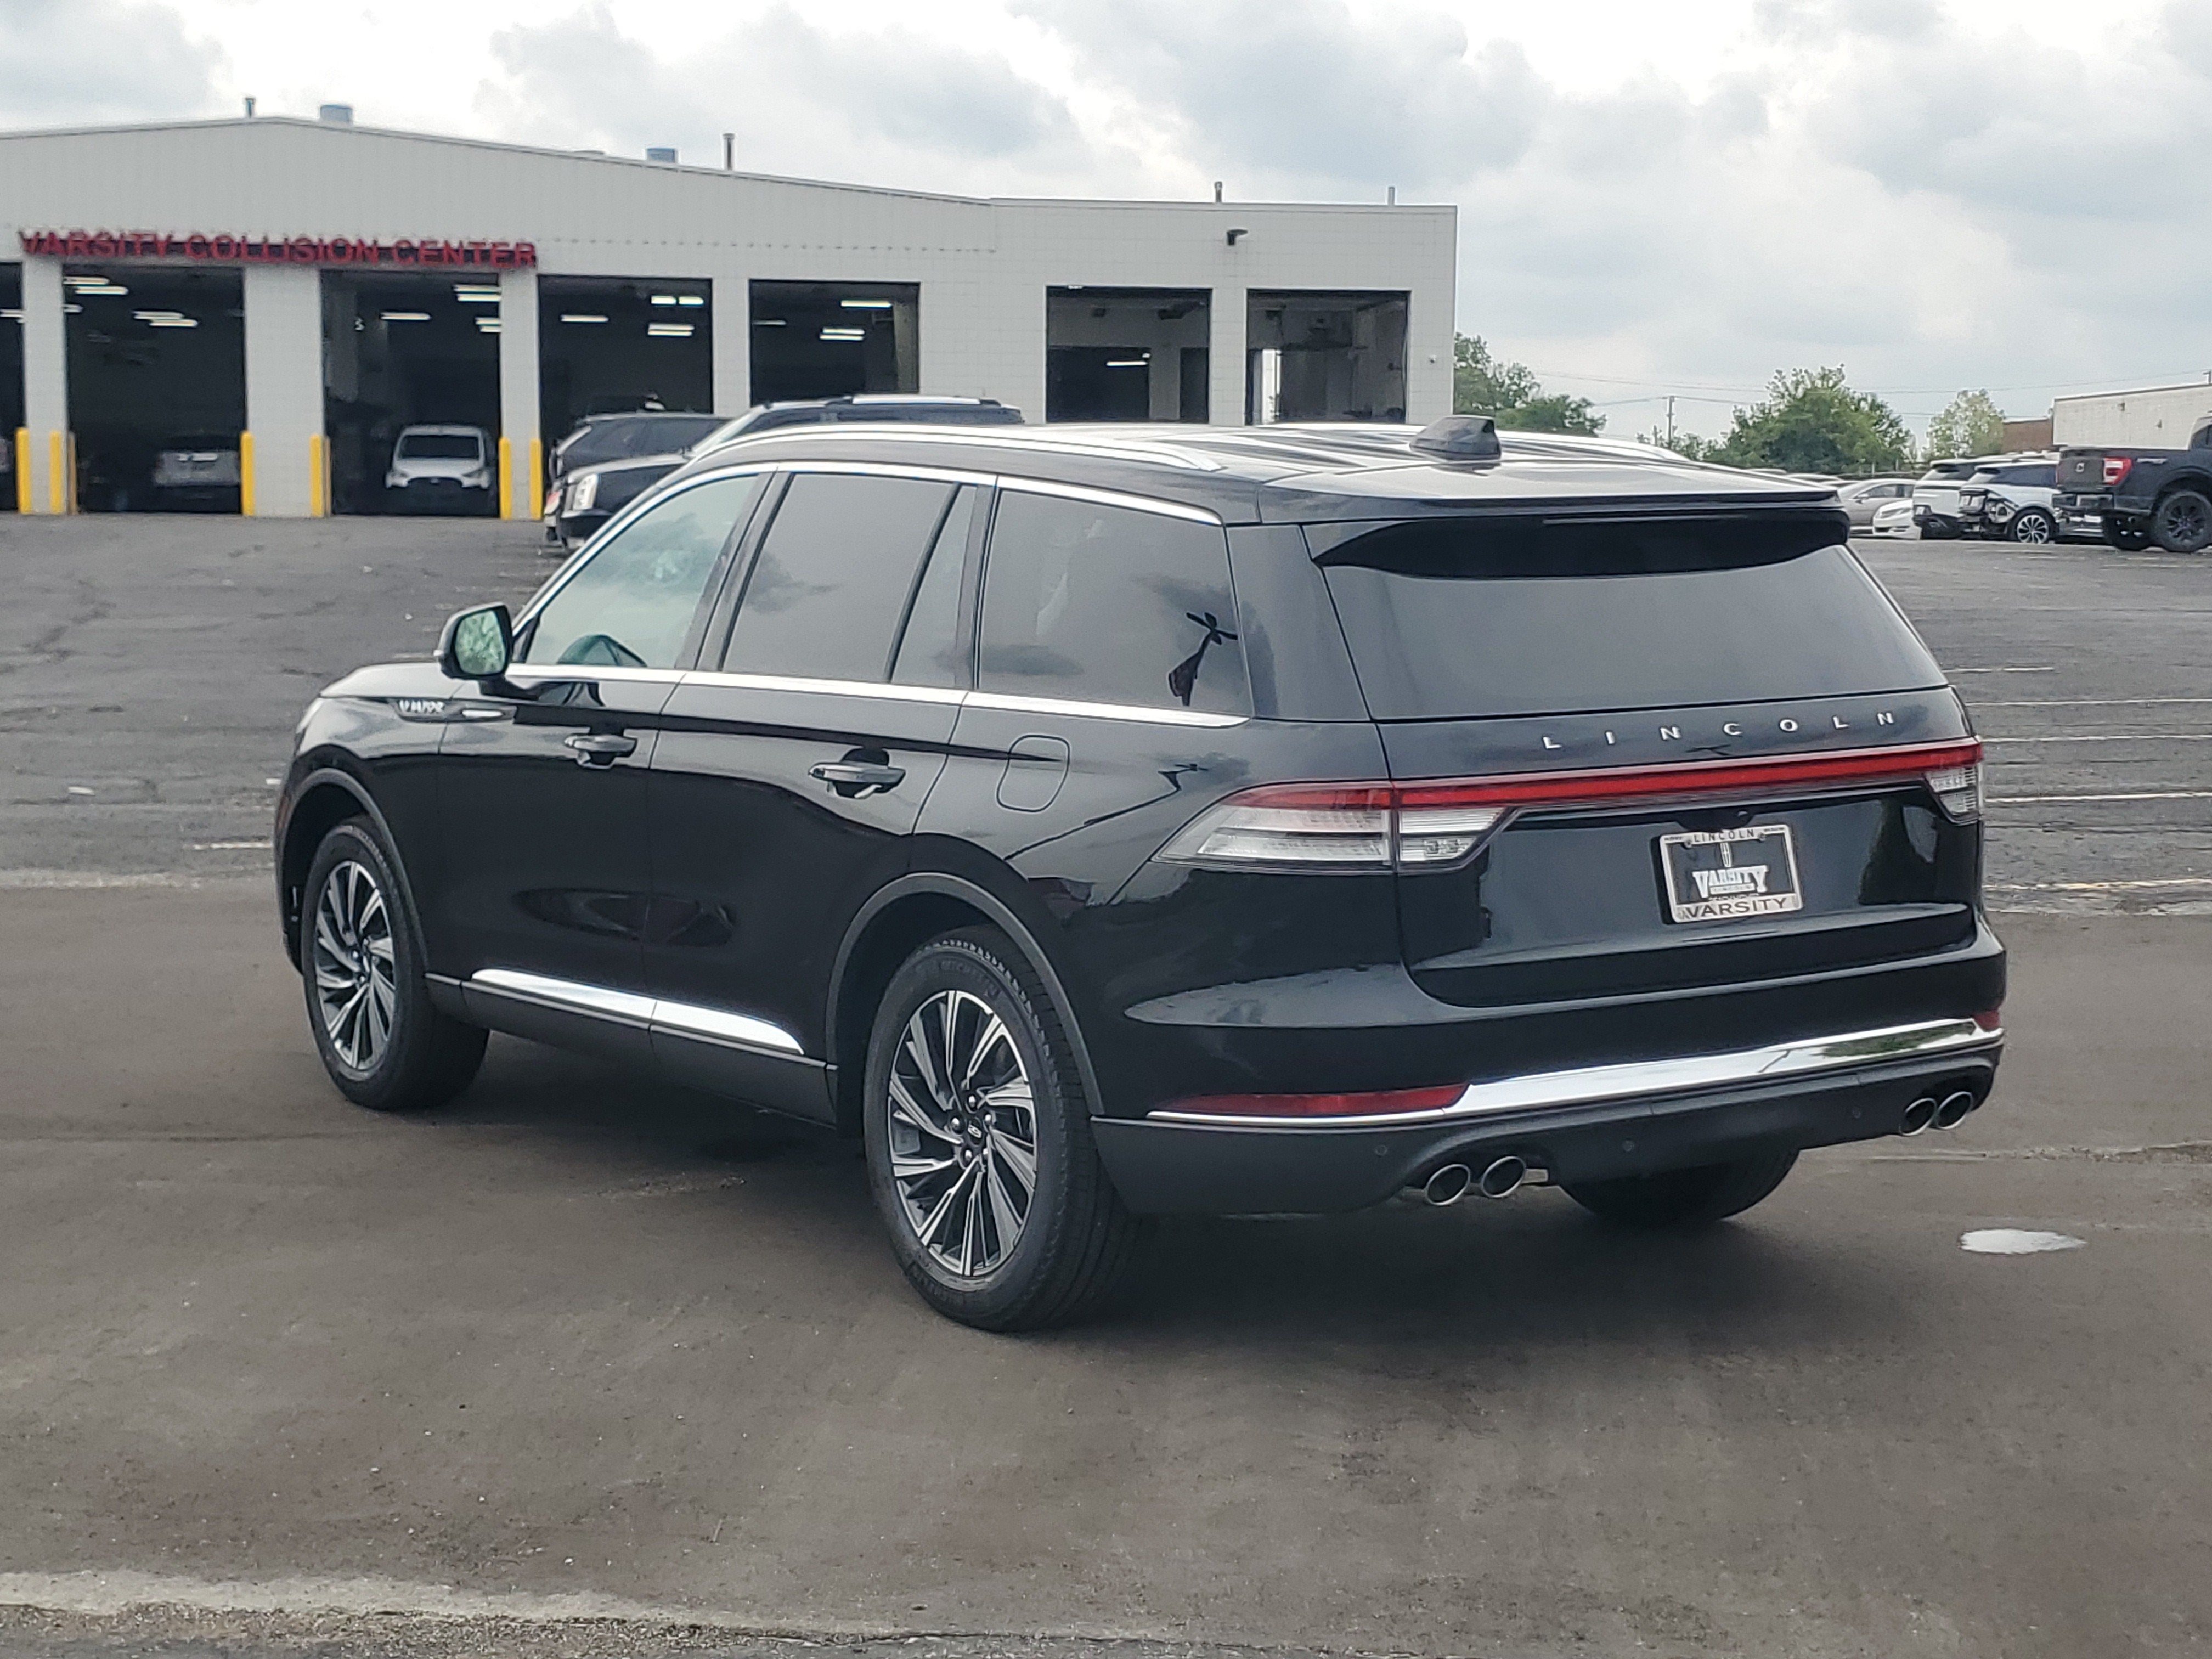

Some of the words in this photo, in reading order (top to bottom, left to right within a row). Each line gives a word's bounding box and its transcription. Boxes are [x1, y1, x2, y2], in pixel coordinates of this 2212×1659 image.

[19, 230, 174, 258] VARSITY
[184, 234, 381, 264] COLLISION
[393, 239, 538, 268] CENTER
[1543, 711, 1895, 750] LINCOLN
[1693, 828, 1755, 843] LINCOLN
[1692, 865, 1768, 899] VARSITY
[1684, 897, 1787, 918] VARSITY
